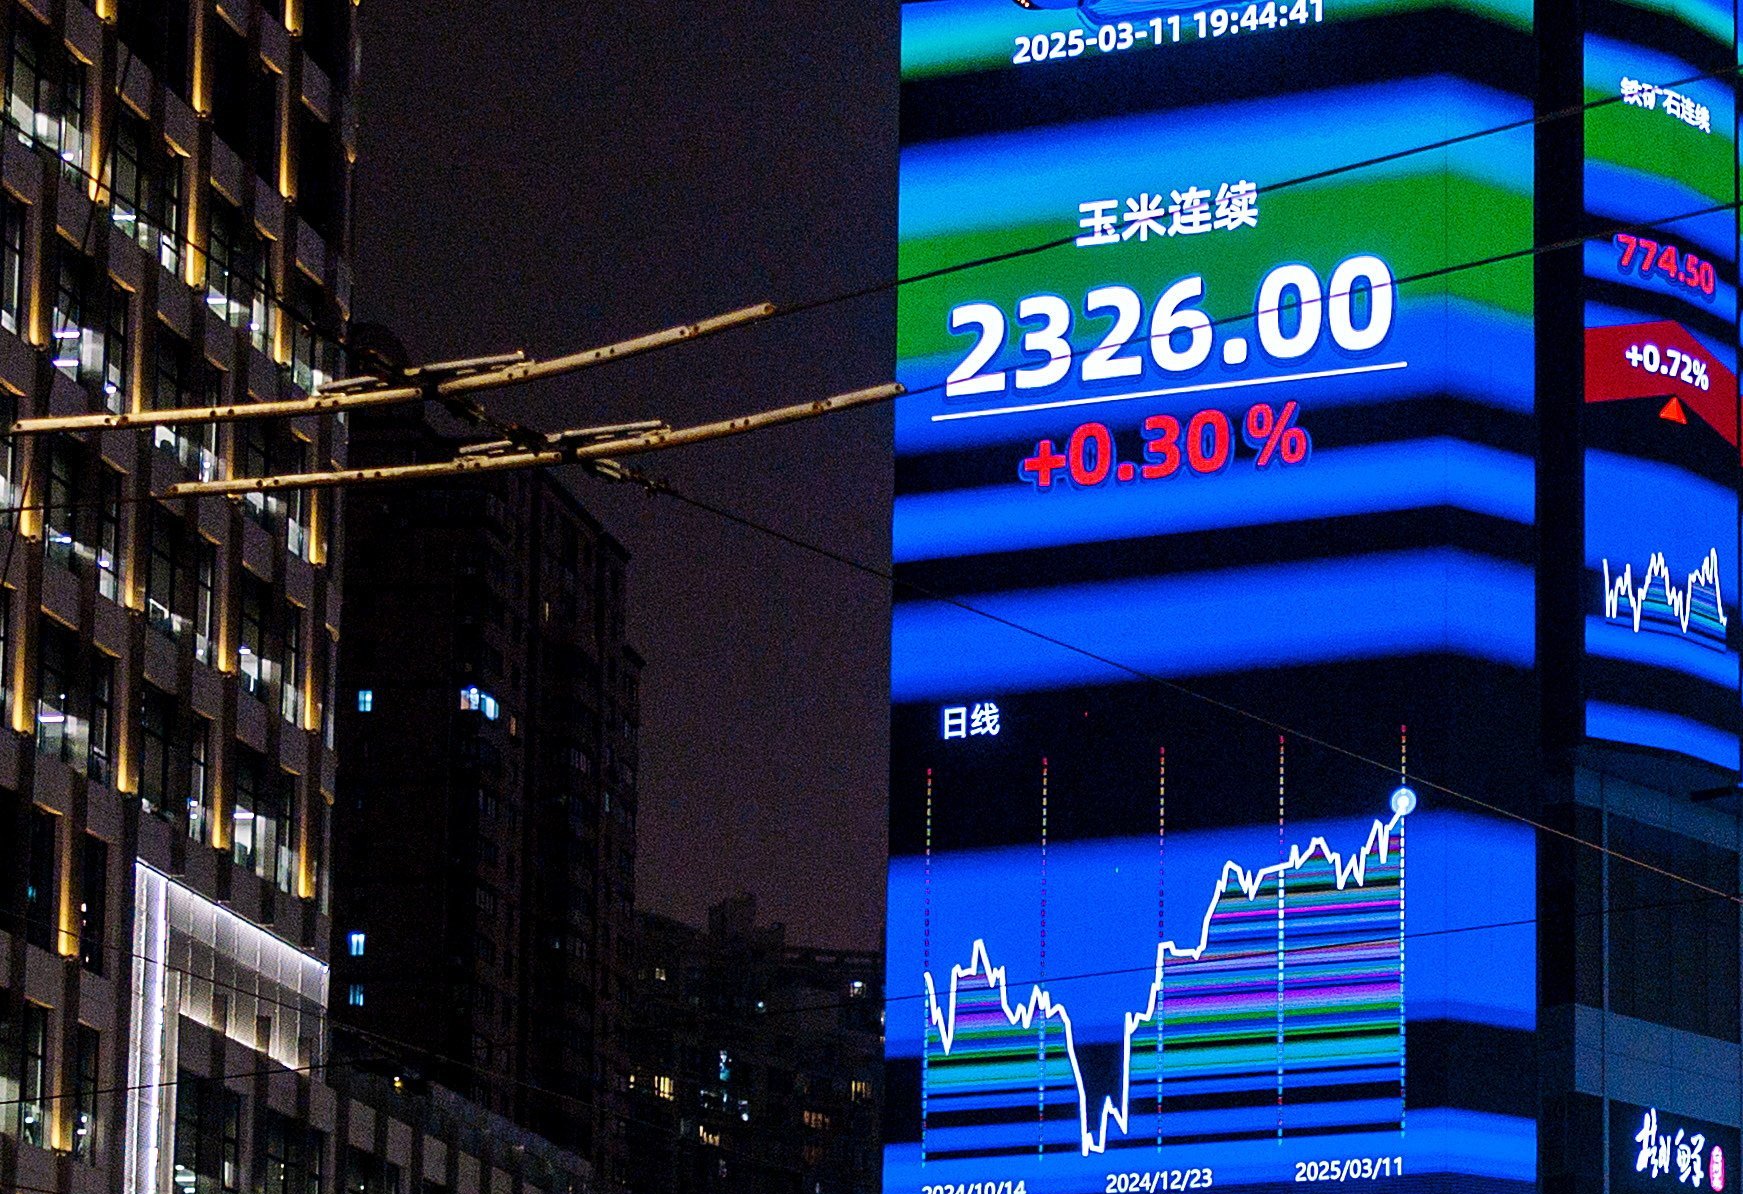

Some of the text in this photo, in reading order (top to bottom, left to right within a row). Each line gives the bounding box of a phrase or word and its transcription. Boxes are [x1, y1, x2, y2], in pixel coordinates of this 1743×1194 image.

[1012, 0, 1323, 65] 2025-03-11 19:44:41
[1076, 180, 1259, 248] 玉米连续
[1616, 233, 1716, 296] 774.50
[945, 255, 1394, 398] 2326.00
[1625, 344, 1710, 392] +0.72%
[943, 703, 1001, 741] 日线
[1295, 1157, 1404, 1184] 2025/03/11
